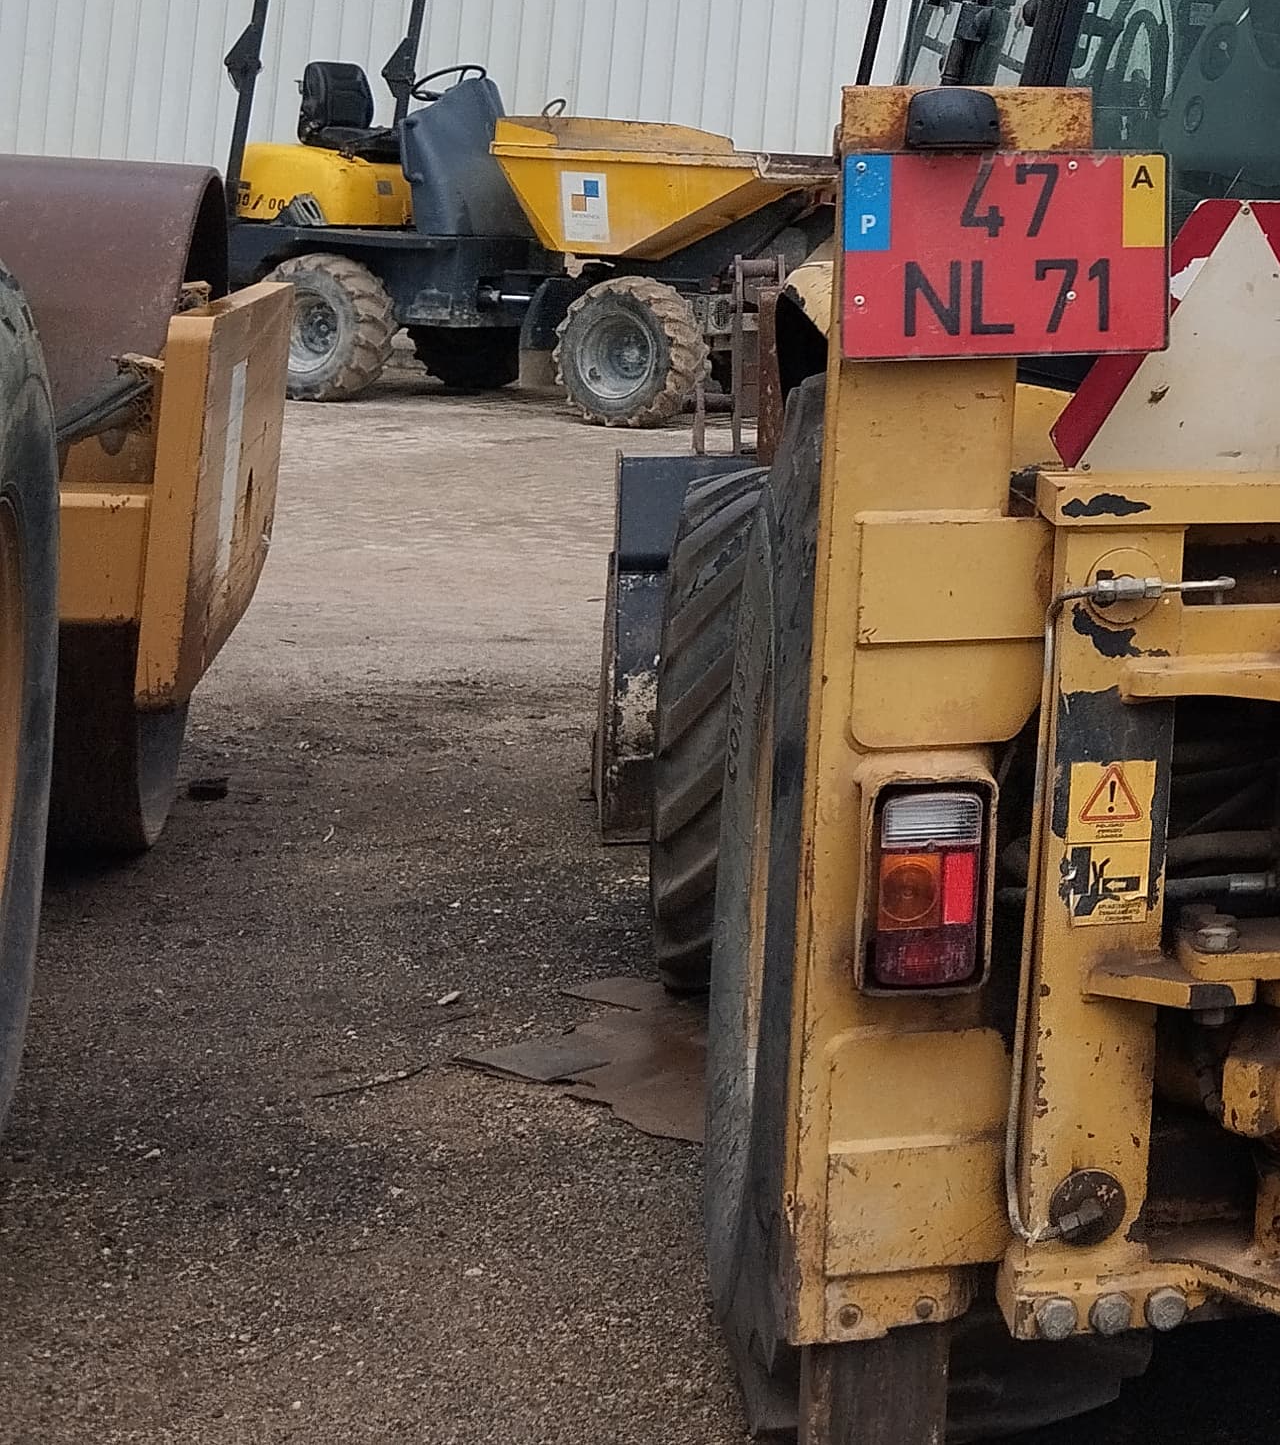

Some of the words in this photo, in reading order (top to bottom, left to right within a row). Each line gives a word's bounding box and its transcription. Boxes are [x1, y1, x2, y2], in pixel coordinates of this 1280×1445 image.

[960, 154, 1059, 238] 47
[1131, 165, 1154, 189] A
[860, 214, 876, 234] P
[904, 259, 1015, 337] NL
[1035, 257, 1110, 333] 71
